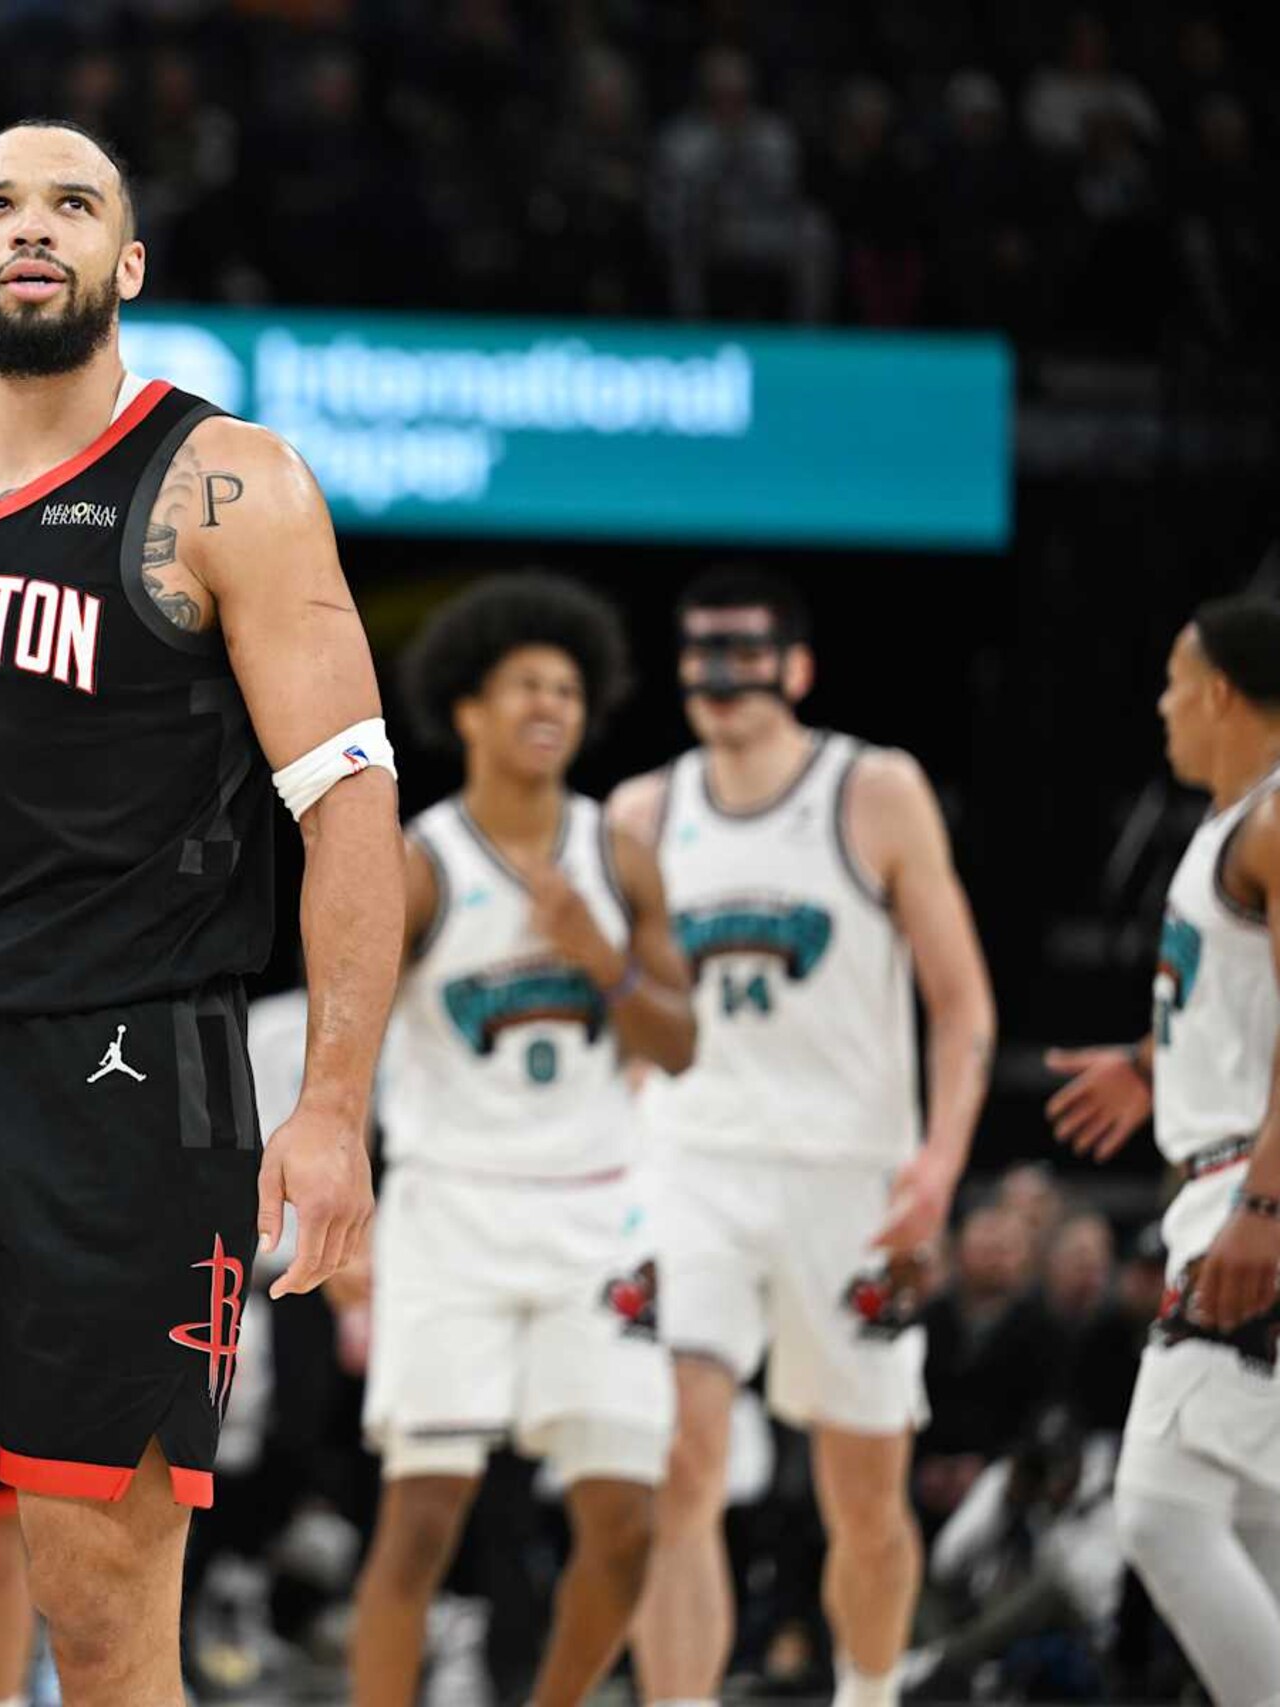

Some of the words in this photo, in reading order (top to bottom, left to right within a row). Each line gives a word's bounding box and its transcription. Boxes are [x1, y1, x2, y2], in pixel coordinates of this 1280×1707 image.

[197, 470, 244, 527] P
[43, 502, 117, 518] MEMORIAL
[41, 512, 116, 527] HERMANN
